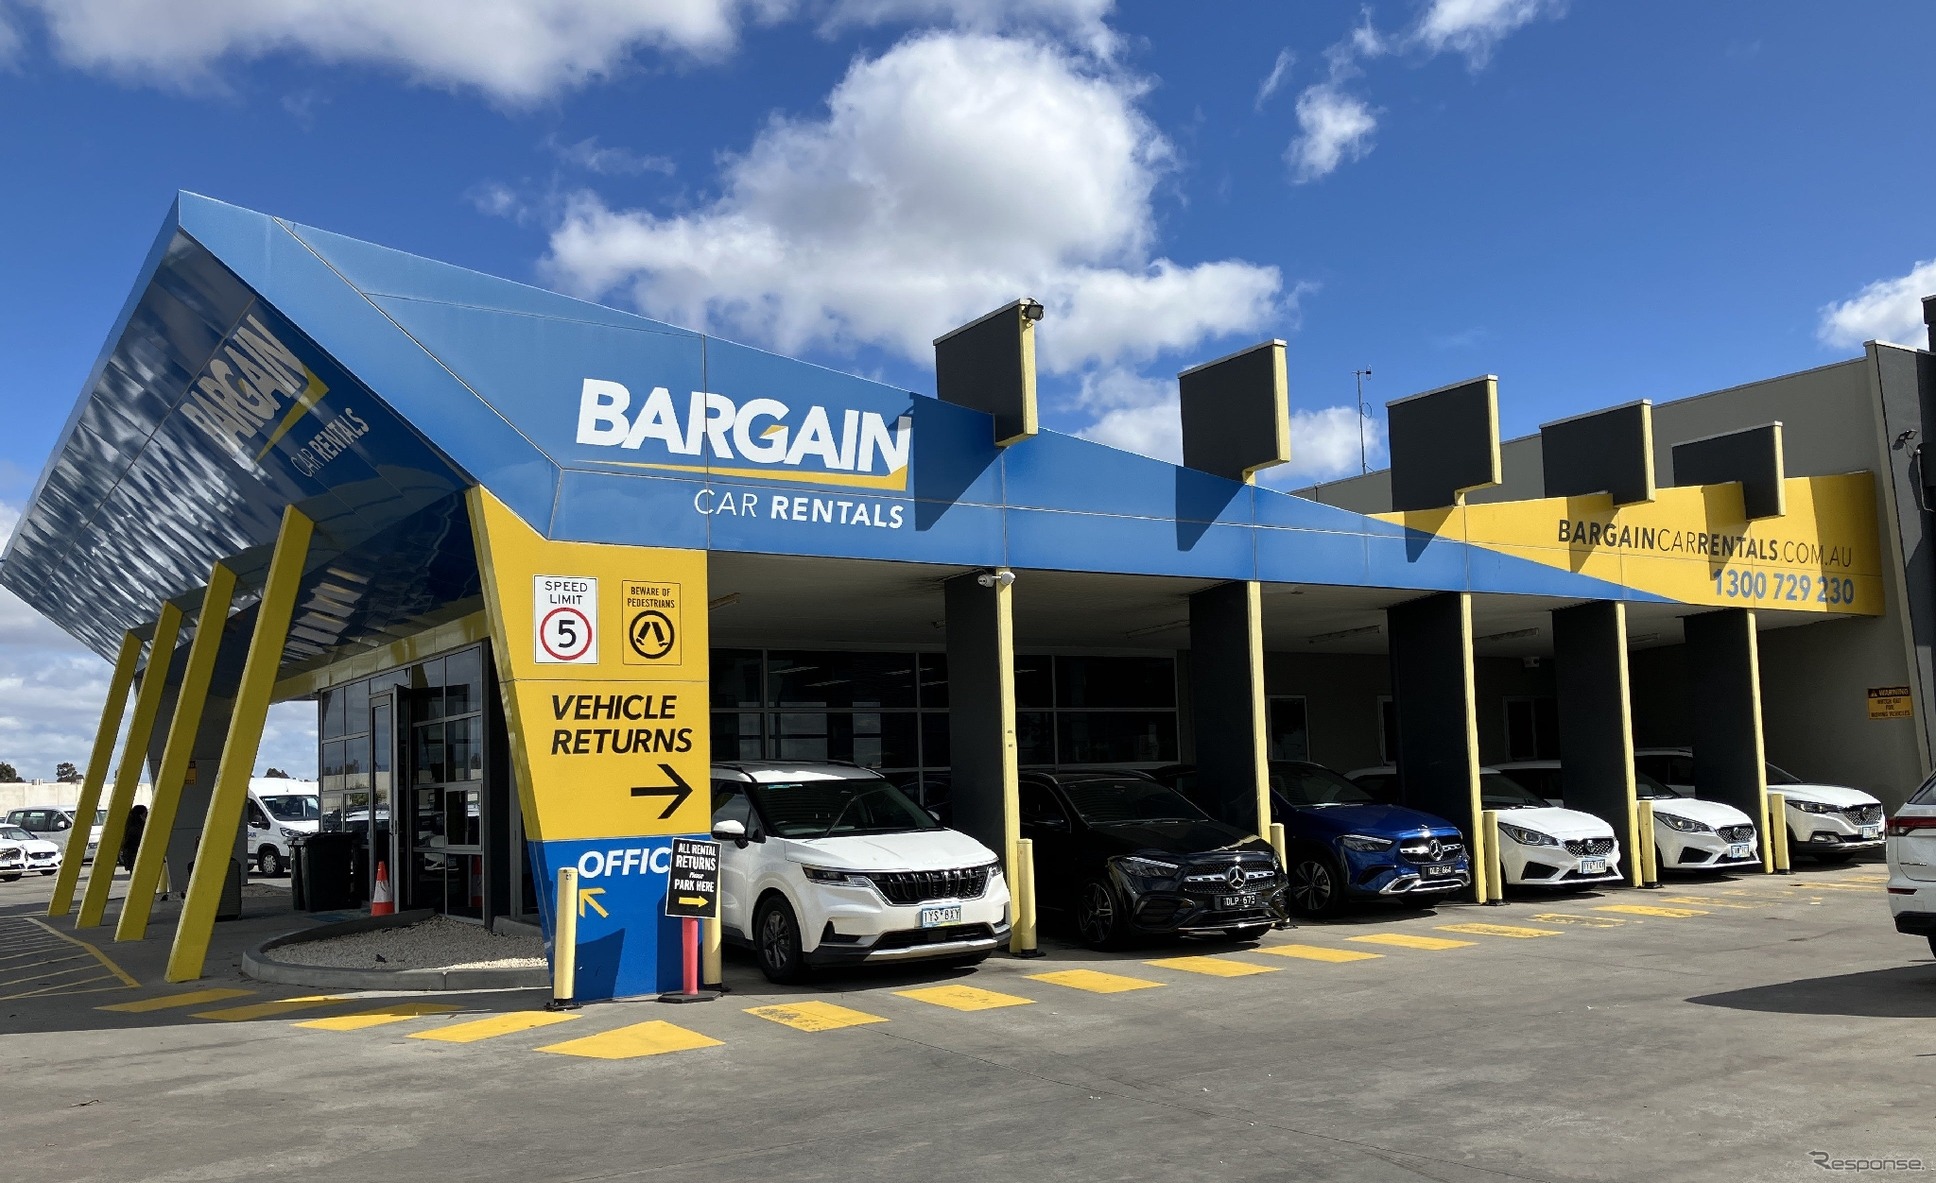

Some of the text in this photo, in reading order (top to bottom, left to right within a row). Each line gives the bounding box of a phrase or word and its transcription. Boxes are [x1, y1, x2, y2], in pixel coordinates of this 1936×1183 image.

[179, 313, 310, 458] BARGAIN
[576, 378, 912, 475] BARGAIN
[291, 407, 370, 478] CAR RENTALS
[694, 489, 904, 529] CAR RENTALS
[545, 581, 588, 593] SPEED
[549, 594, 583, 605] LIMIT
[630, 587, 671, 597] BEWARE OF
[1713, 569, 1855, 604] 1300 729 230
[627, 598, 675, 608] PEDESTRIANS
[557, 619, 577, 648] 5
[551, 695, 677, 720] VEHICLE
[551, 728, 693, 755] RETURNS
[675, 854, 717, 871] RETURNS
[678, 843, 717, 856] ALL RENTAL
[578, 847, 672, 879] OFFIC
[674, 878, 715, 893] PARK HERE
